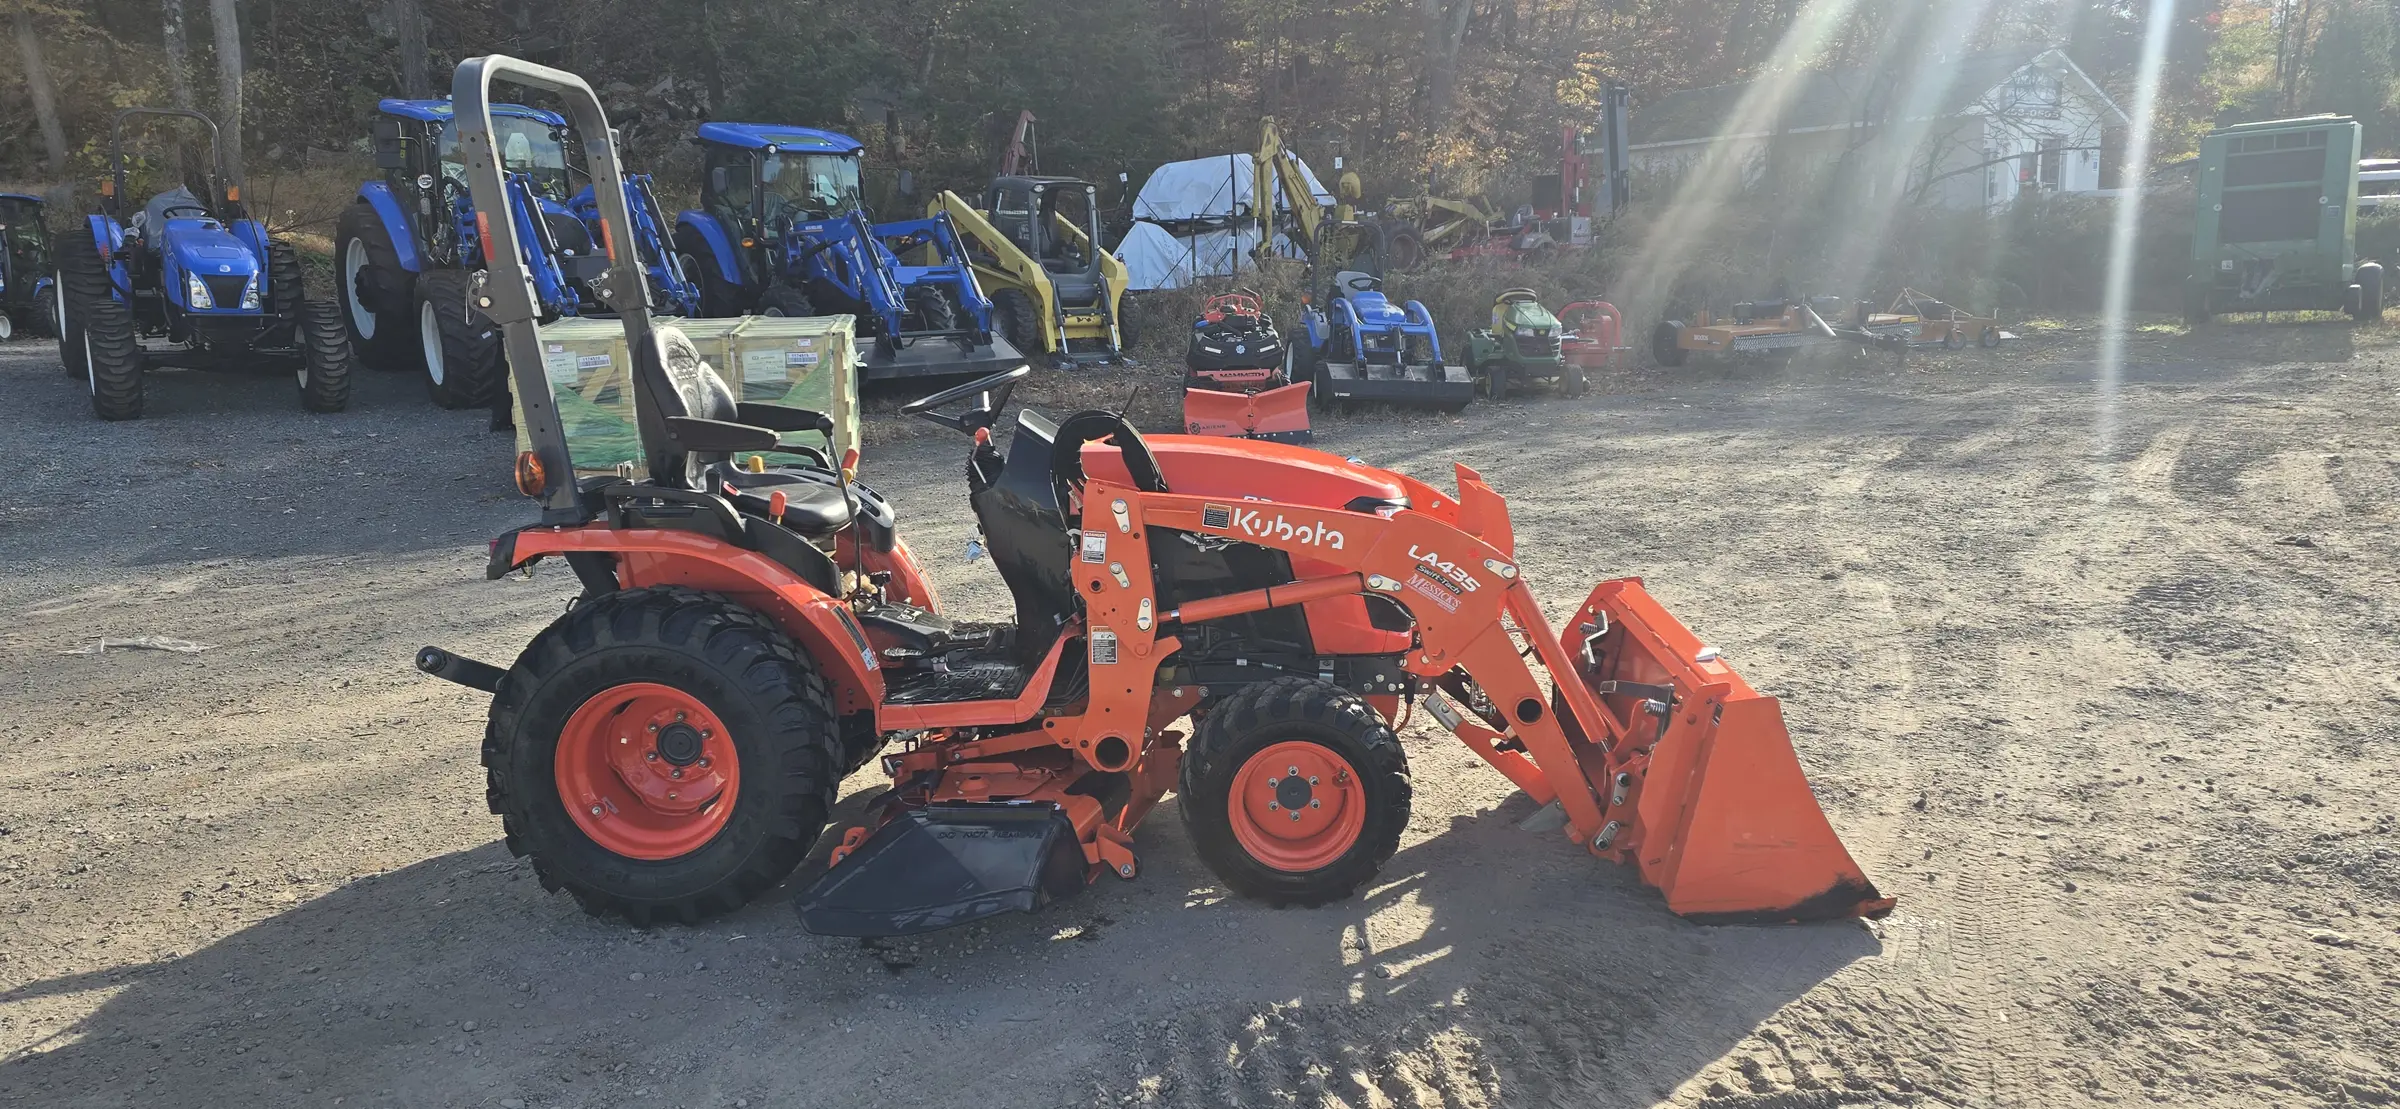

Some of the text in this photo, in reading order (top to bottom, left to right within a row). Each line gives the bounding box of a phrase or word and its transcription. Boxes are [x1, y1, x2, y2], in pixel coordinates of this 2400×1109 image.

[1233, 508, 1345, 550] Kubota
[1408, 544, 1481, 592] LA435
[1417, 565, 1461, 594] Swift-Tech
[1406, 573, 1462, 608] MESSICK'S
[962, 830, 989, 839] NOT
